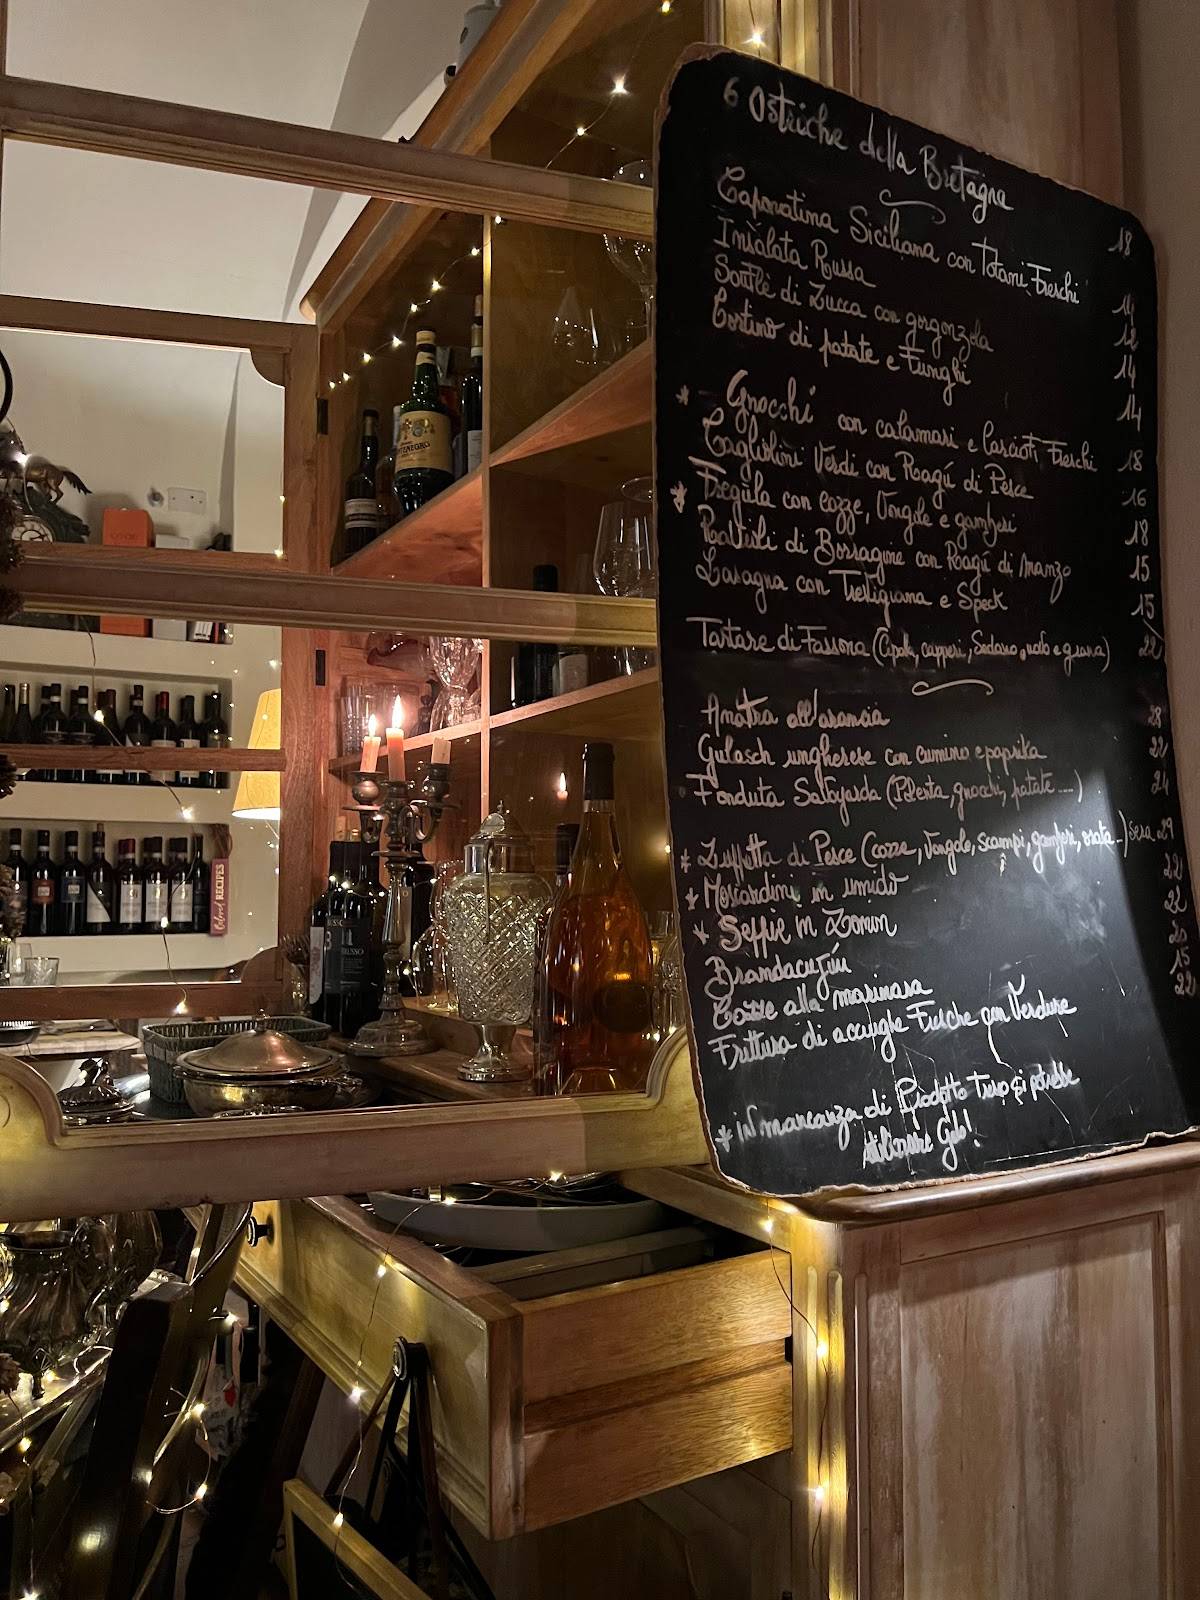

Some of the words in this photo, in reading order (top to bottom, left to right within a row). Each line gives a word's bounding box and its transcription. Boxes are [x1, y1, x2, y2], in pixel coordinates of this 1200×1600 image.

[859, 112, 917, 176] della
[1108, 227, 1132, 257] 18
[713, 216, 808, 270] Insalata
[811, 238, 877, 288] Russa
[850, 206, 940, 263] Siciliana
[947, 252, 976, 274] con
[780, 275, 802, 305] di
[809, 281, 867, 318] Zucca
[874, 305, 900, 324] con
[789, 320, 812, 348] di
[819, 328, 879, 367] patate
[886, 355, 900, 371] e
[1116, 394, 1141, 431] 14
[727, 369, 816, 434] Gnocchi
[838, 413, 867, 435] con
[876, 409, 959, 448] calamari
[967, 439, 978, 452] e
[1117, 450, 1143, 472] 18
[814, 441, 859, 476] Verdi
[866, 460, 896, 482] con
[963, 468, 983, 494] di
[984, 463, 1034, 499] Pesce
[1121, 488, 1147, 507] 16
[782, 491, 812, 511] con
[940, 512, 951, 528] e
[1124, 518, 1149, 546] 18
[785, 527, 808, 554] di
[915, 551, 942, 569] con
[997, 551, 1014, 577] di
[1129, 555, 1150, 582] 15
[695, 546, 789, 614] Lasagna
[795, 575, 831, 595] con
[940, 595, 952, 608] e
[957, 581, 1008, 623] Speck
[685, 616, 775, 653] Tartare
[777, 623, 801, 652] di
[797, 625, 870, 657] Fassona
[701, 687, 779, 737] Anatra
[698, 733, 776, 789] Gulasch
[685, 773, 785, 808] Fonduta
[787, 838, 810, 866] di
[808, 830, 857, 867] Pesce
[215, 863, 225, 900] RECIPES
[811, 872, 833, 904] in
[842, 863, 909, 898] umido
[718, 908, 791, 959] Seppie
[795, 904, 817, 938] in
[783, 983, 824, 1016] alla
[833, 973, 933, 1010] marinara
[802, 1020, 828, 1050] di
[1008, 974, 1077, 1020] Verdure
[864, 1088, 892, 1118] di
